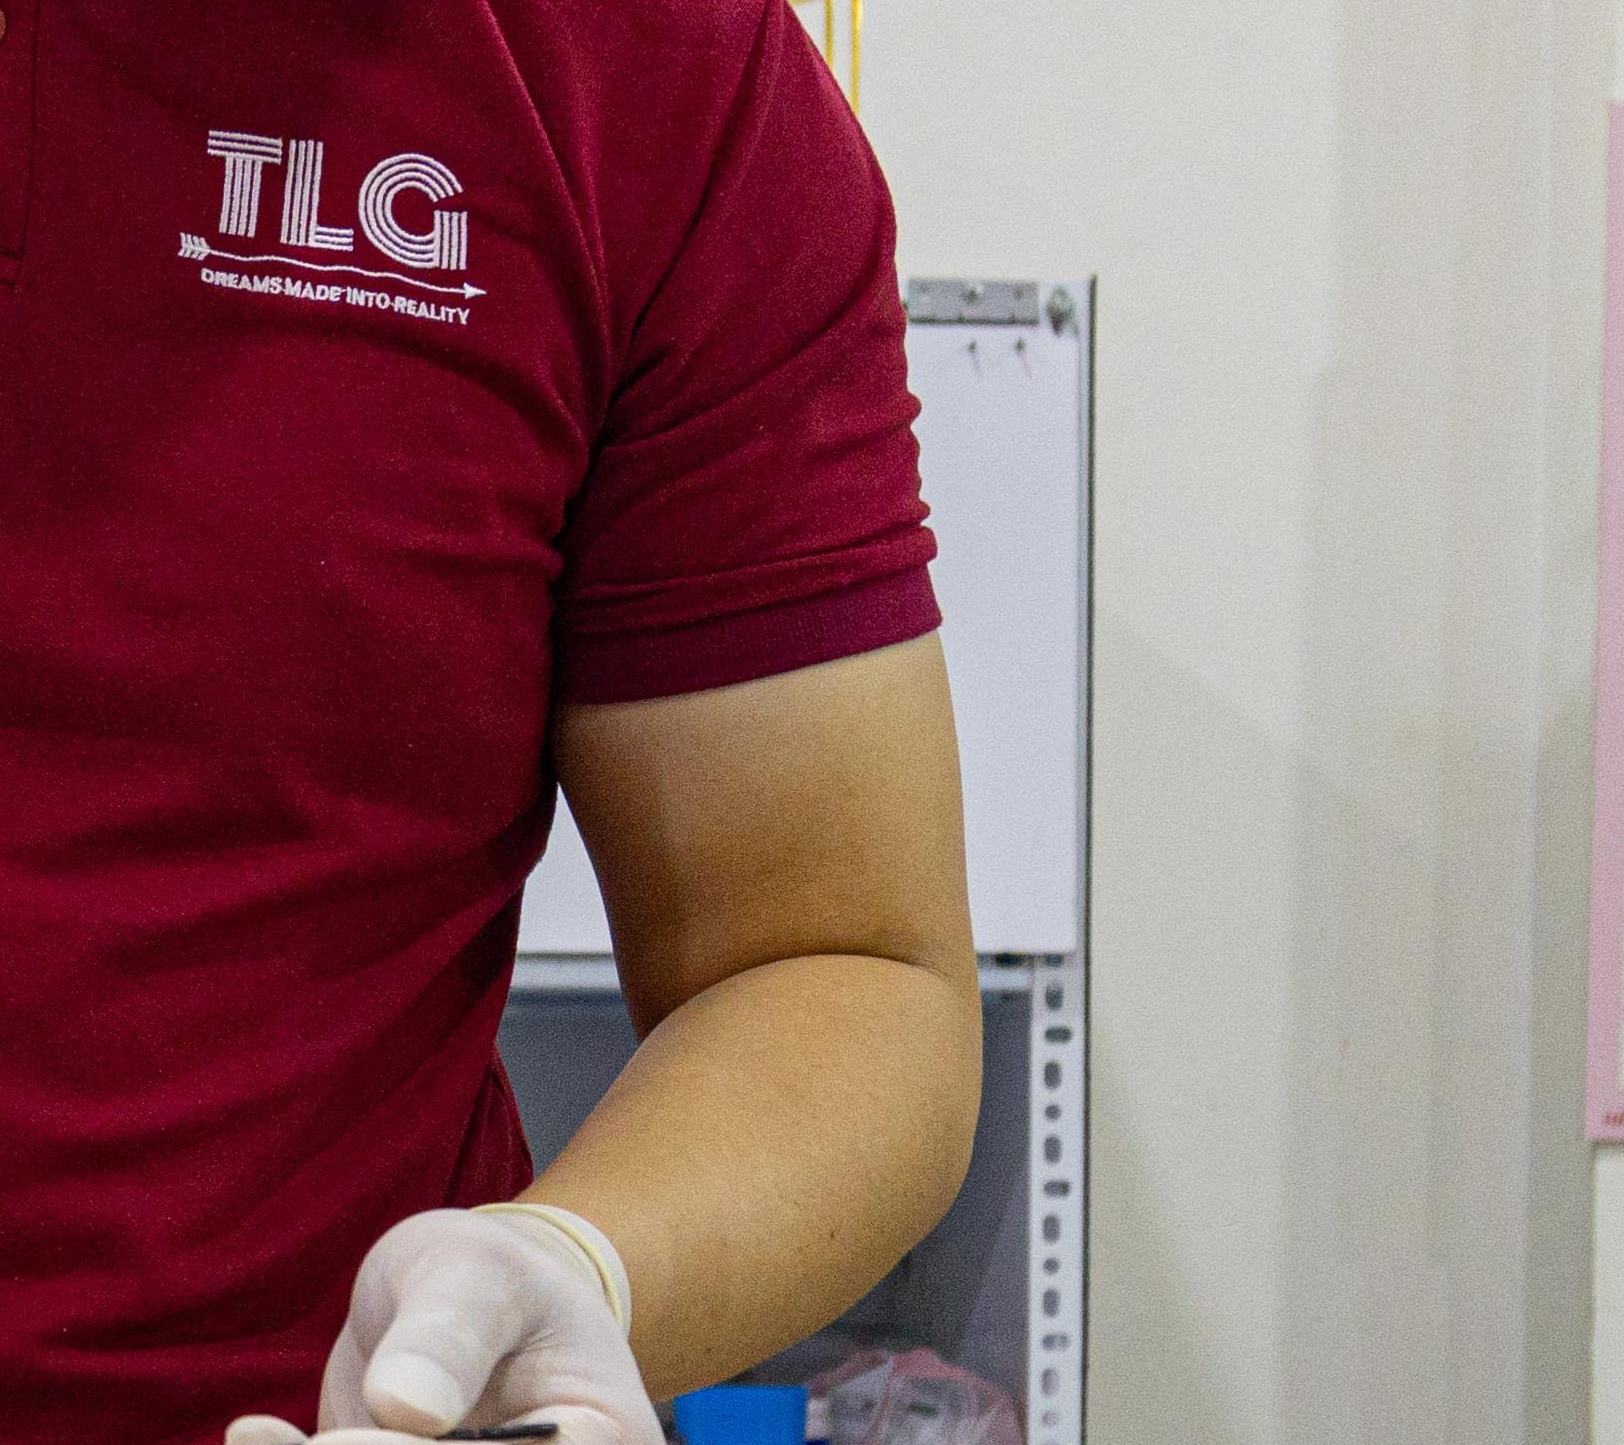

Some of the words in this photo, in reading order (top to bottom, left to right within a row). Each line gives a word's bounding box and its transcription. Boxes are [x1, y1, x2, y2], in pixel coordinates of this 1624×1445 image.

[207, 130, 468, 270] TLG
[201, 268, 283, 294] DREAMS
[286, 278, 342, 301] MADE
[346, 287, 392, 310] INTO
[394, 298, 470, 324] REALITY
